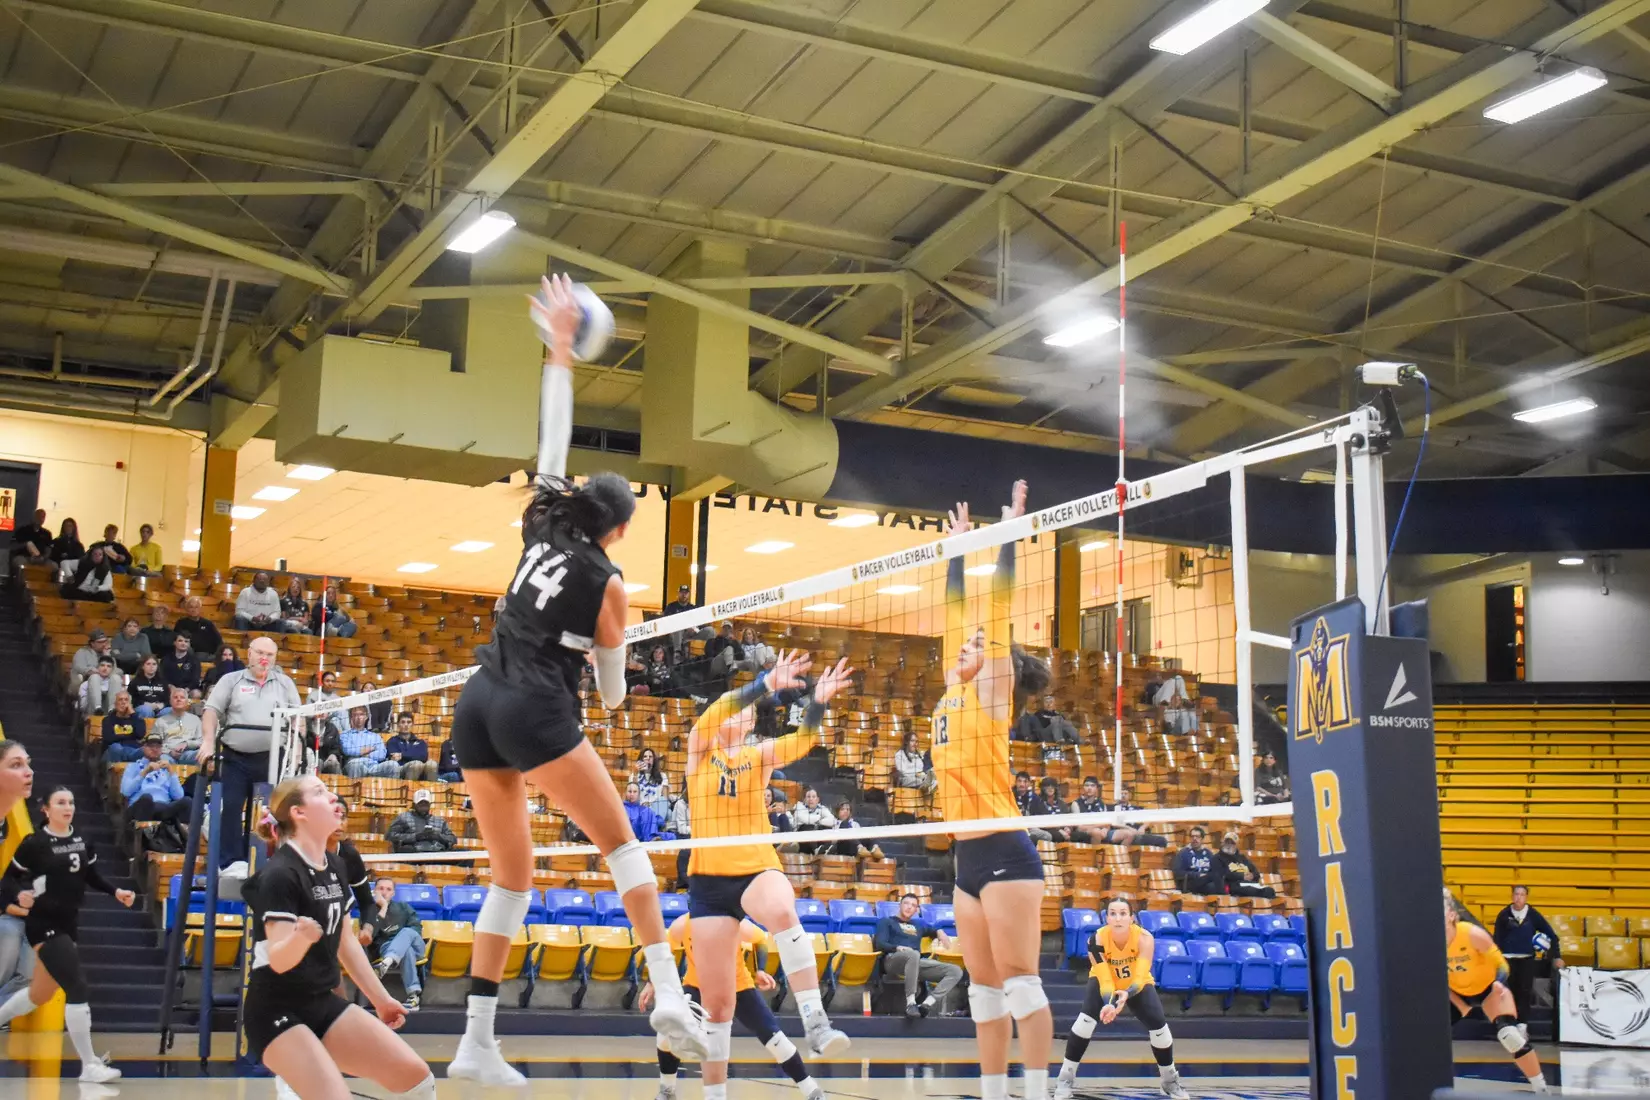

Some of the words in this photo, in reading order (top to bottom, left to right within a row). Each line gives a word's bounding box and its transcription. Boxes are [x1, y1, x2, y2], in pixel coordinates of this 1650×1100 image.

[1041, 506, 1074, 527] RACER
[859, 559, 885, 577] RACER
[885, 546, 936, 571] VOLLEYBALL
[511, 541, 573, 611] 14
[717, 603, 738, 615] RACER
[738, 592, 778, 611] VOLLEYBALL
[69, 853, 81, 873] 3
[326, 902, 341, 935] 17
[1115, 965, 1131, 979] 15
